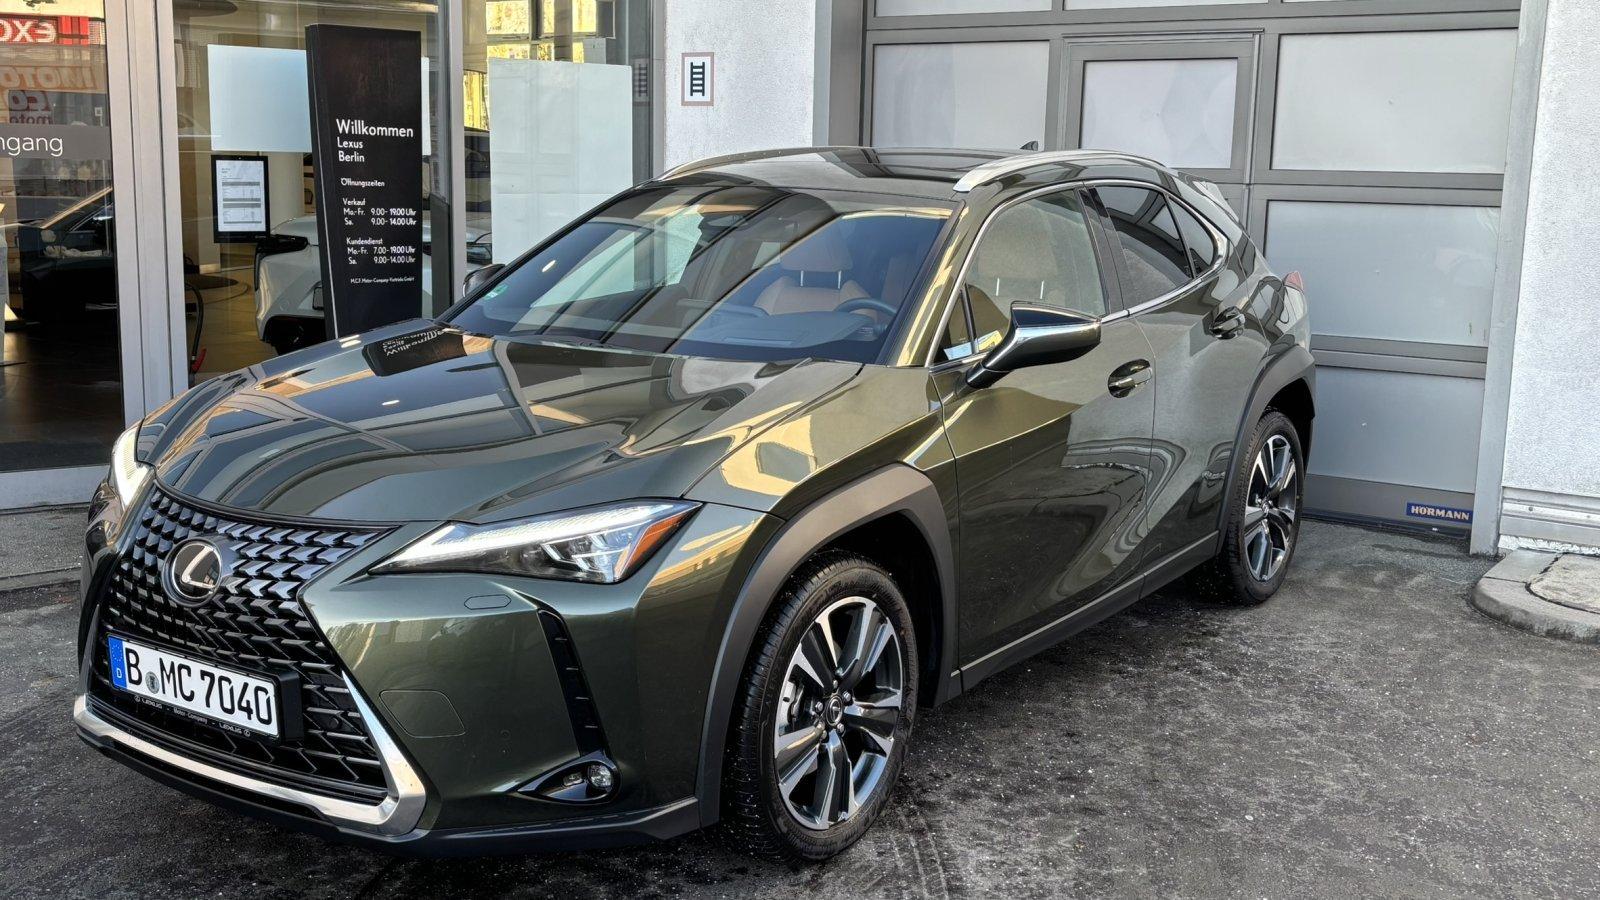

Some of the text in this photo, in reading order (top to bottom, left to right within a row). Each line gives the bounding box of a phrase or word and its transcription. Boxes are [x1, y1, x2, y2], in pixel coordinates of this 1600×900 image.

[336, 118, 414, 138] Willkommen
[337, 136, 364, 149] Lexus
[338, 150, 365, 162] Berlin
[340, 177, 385, 188] Öffnungszeiten
[342, 197, 367, 206] Verkauf
[405, 208, 417, 216] Uhr
[344, 217, 354, 226] Sa.
[405, 217, 417, 226] Uhr
[346, 237, 383, 245] Kundendienst
[405, 246, 416, 254] Uhr
[348, 257, 358, 265] Sa.
[405, 256, 416, 264] Uhr
[116, 667, 123, 679] D
[125, 647, 273, 726] B MC 7040
